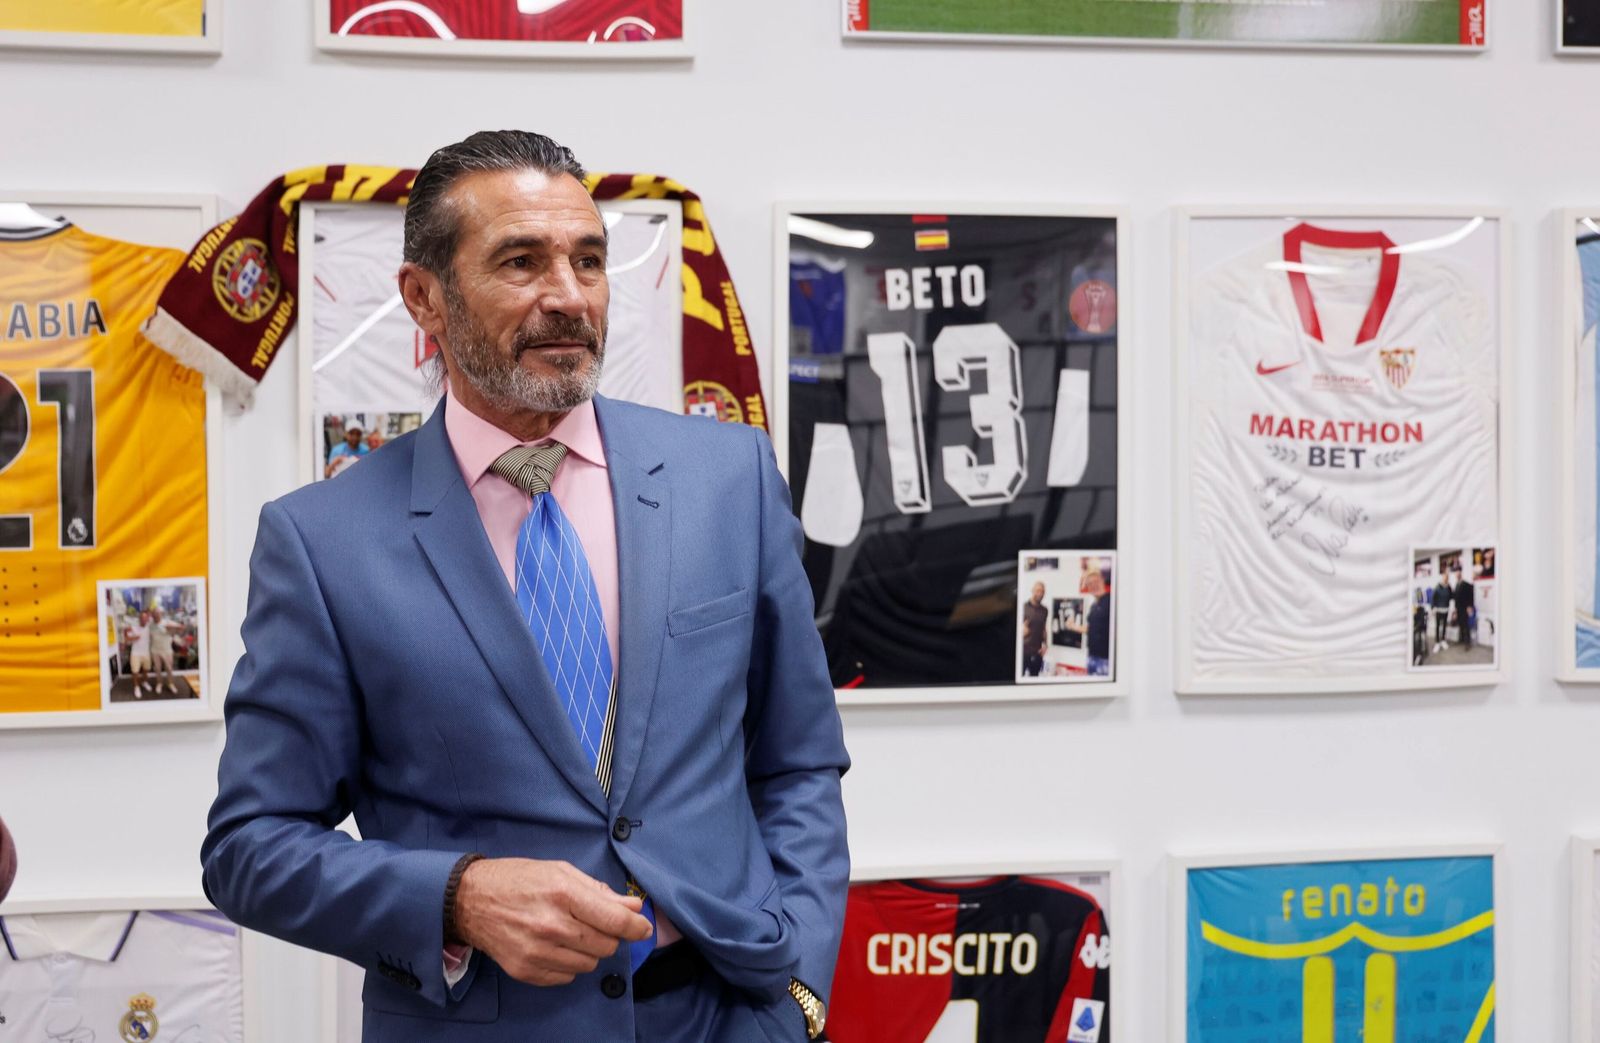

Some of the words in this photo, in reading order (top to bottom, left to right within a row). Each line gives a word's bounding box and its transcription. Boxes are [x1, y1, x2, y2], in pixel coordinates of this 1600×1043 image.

[885, 264, 986, 311] BETO
[0, 300, 107, 340] ABIA
[867, 323, 1028, 514] 13
[1250, 414, 1423, 444] MARATHON
[1307, 446, 1367, 469] BET
[1282, 876, 1425, 922] renato
[866, 932, 1038, 976] CRISCITO
